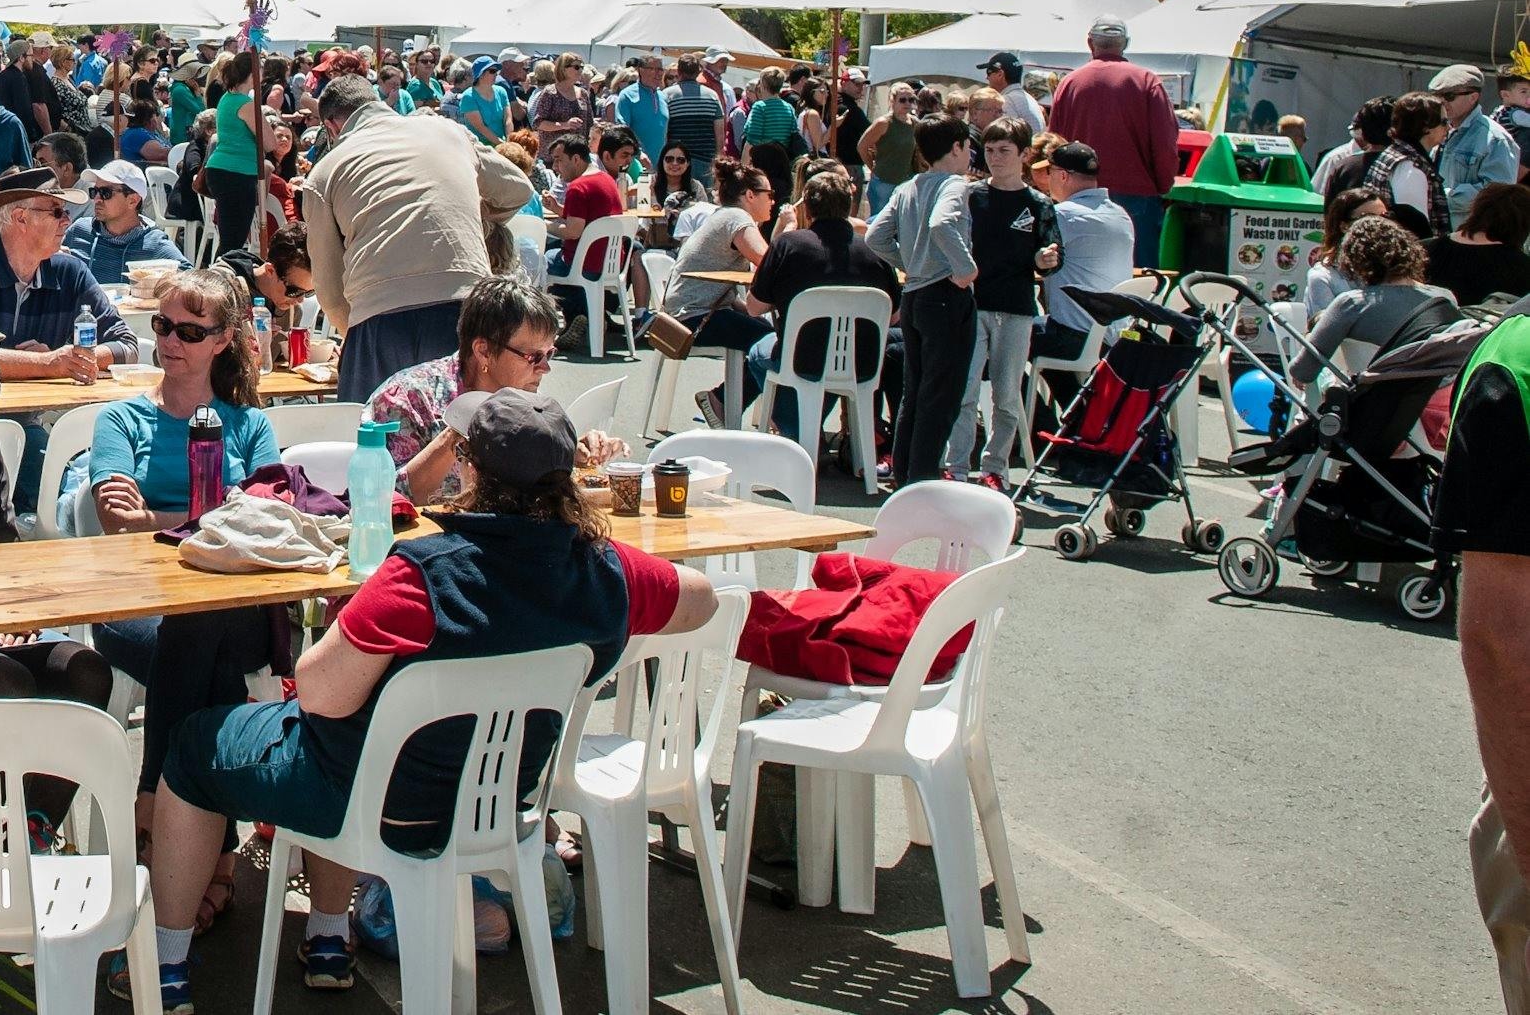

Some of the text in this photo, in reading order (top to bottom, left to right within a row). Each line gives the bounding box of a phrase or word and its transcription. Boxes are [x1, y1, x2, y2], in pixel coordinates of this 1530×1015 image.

[1245, 215, 1269, 227] Food
[1272, 218, 1290, 228] and
[1243, 227, 1301, 241] Waste ONLY
